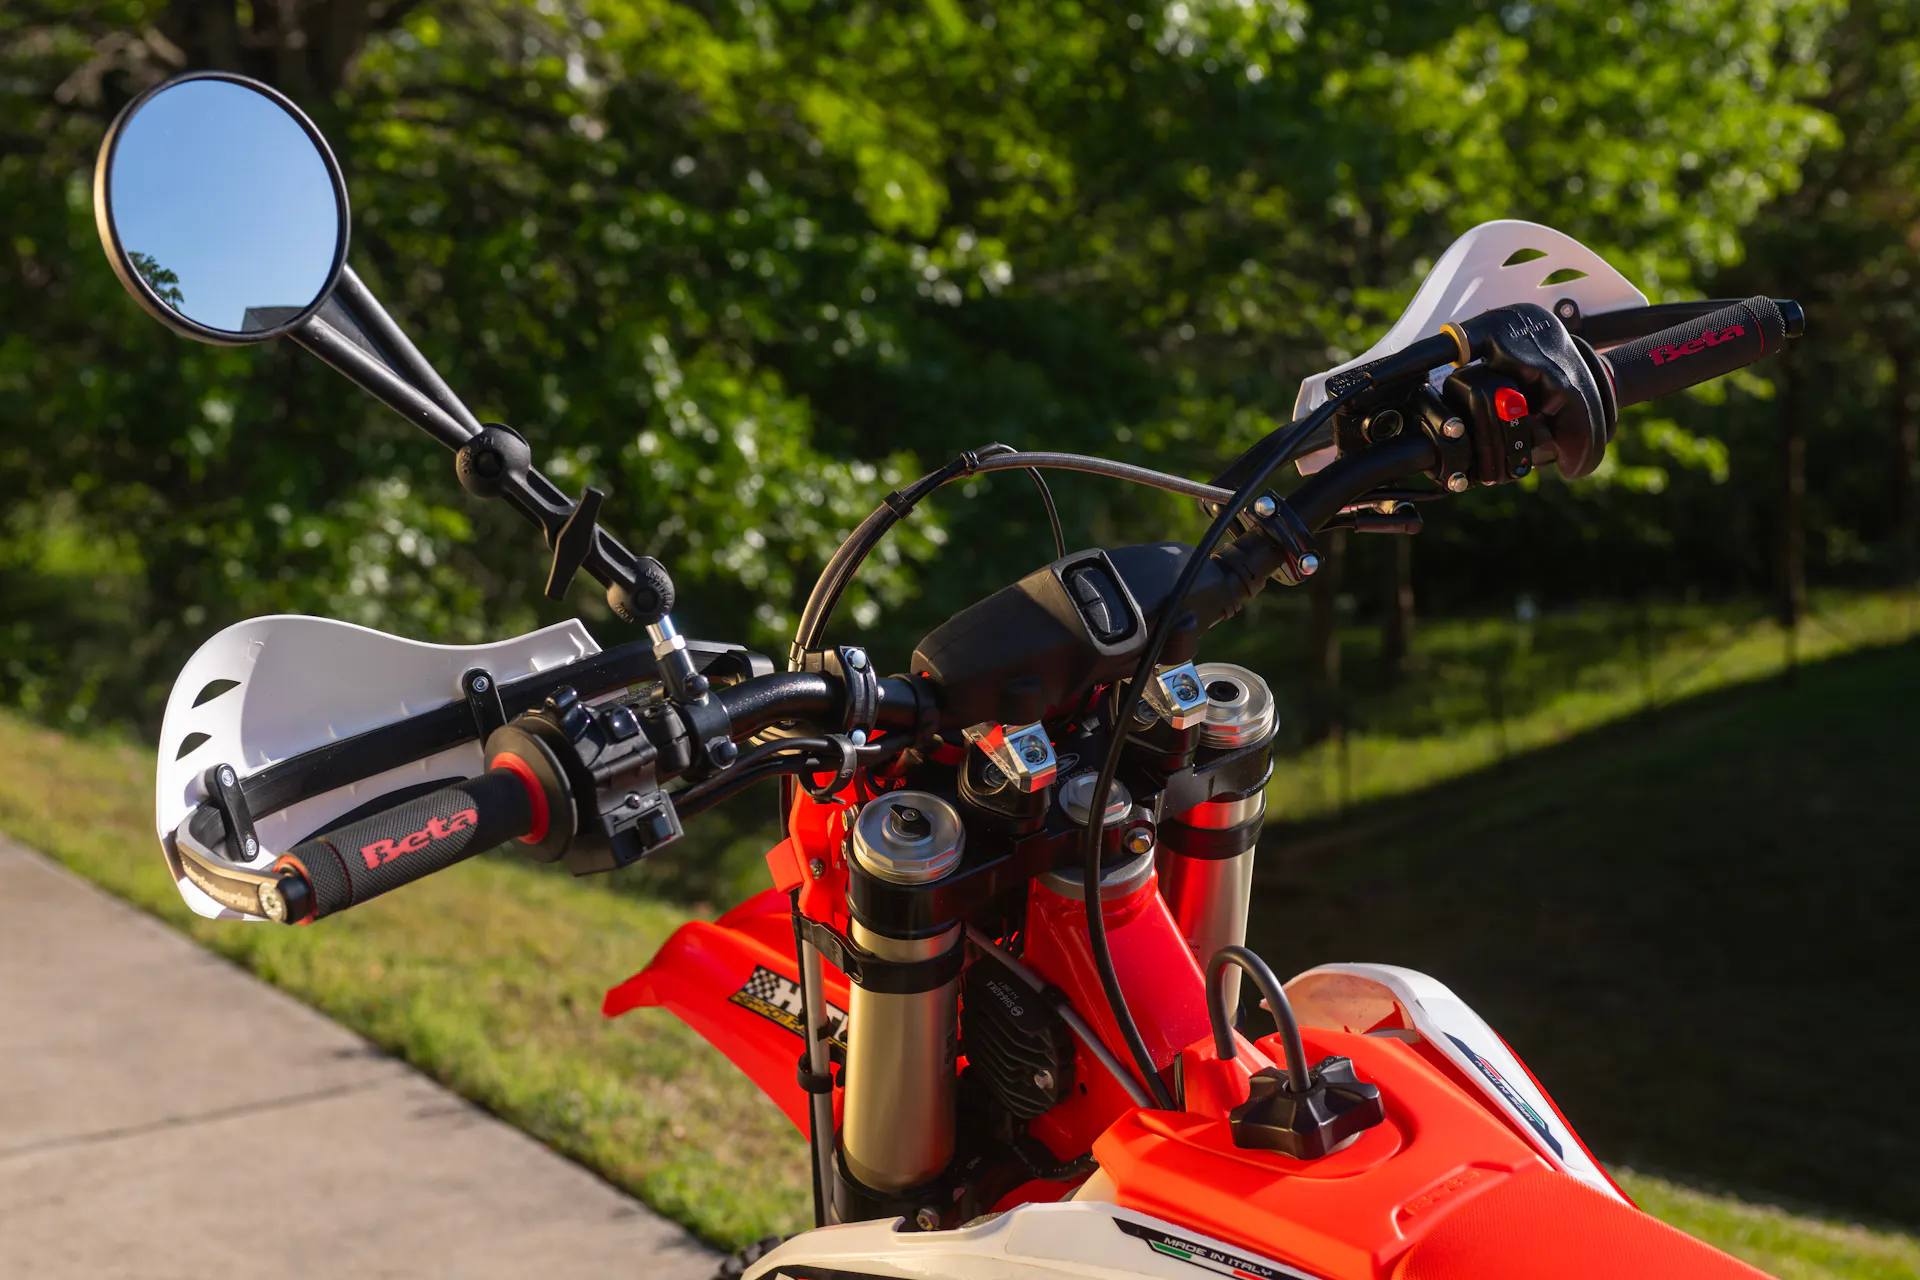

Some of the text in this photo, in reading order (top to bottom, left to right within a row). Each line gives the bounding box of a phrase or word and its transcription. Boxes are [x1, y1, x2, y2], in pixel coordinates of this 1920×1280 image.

[1649, 324, 1745, 366] Beta
[360, 808, 479, 870] Beta
[1163, 1237, 1273, 1277] MADE IN ITALY
